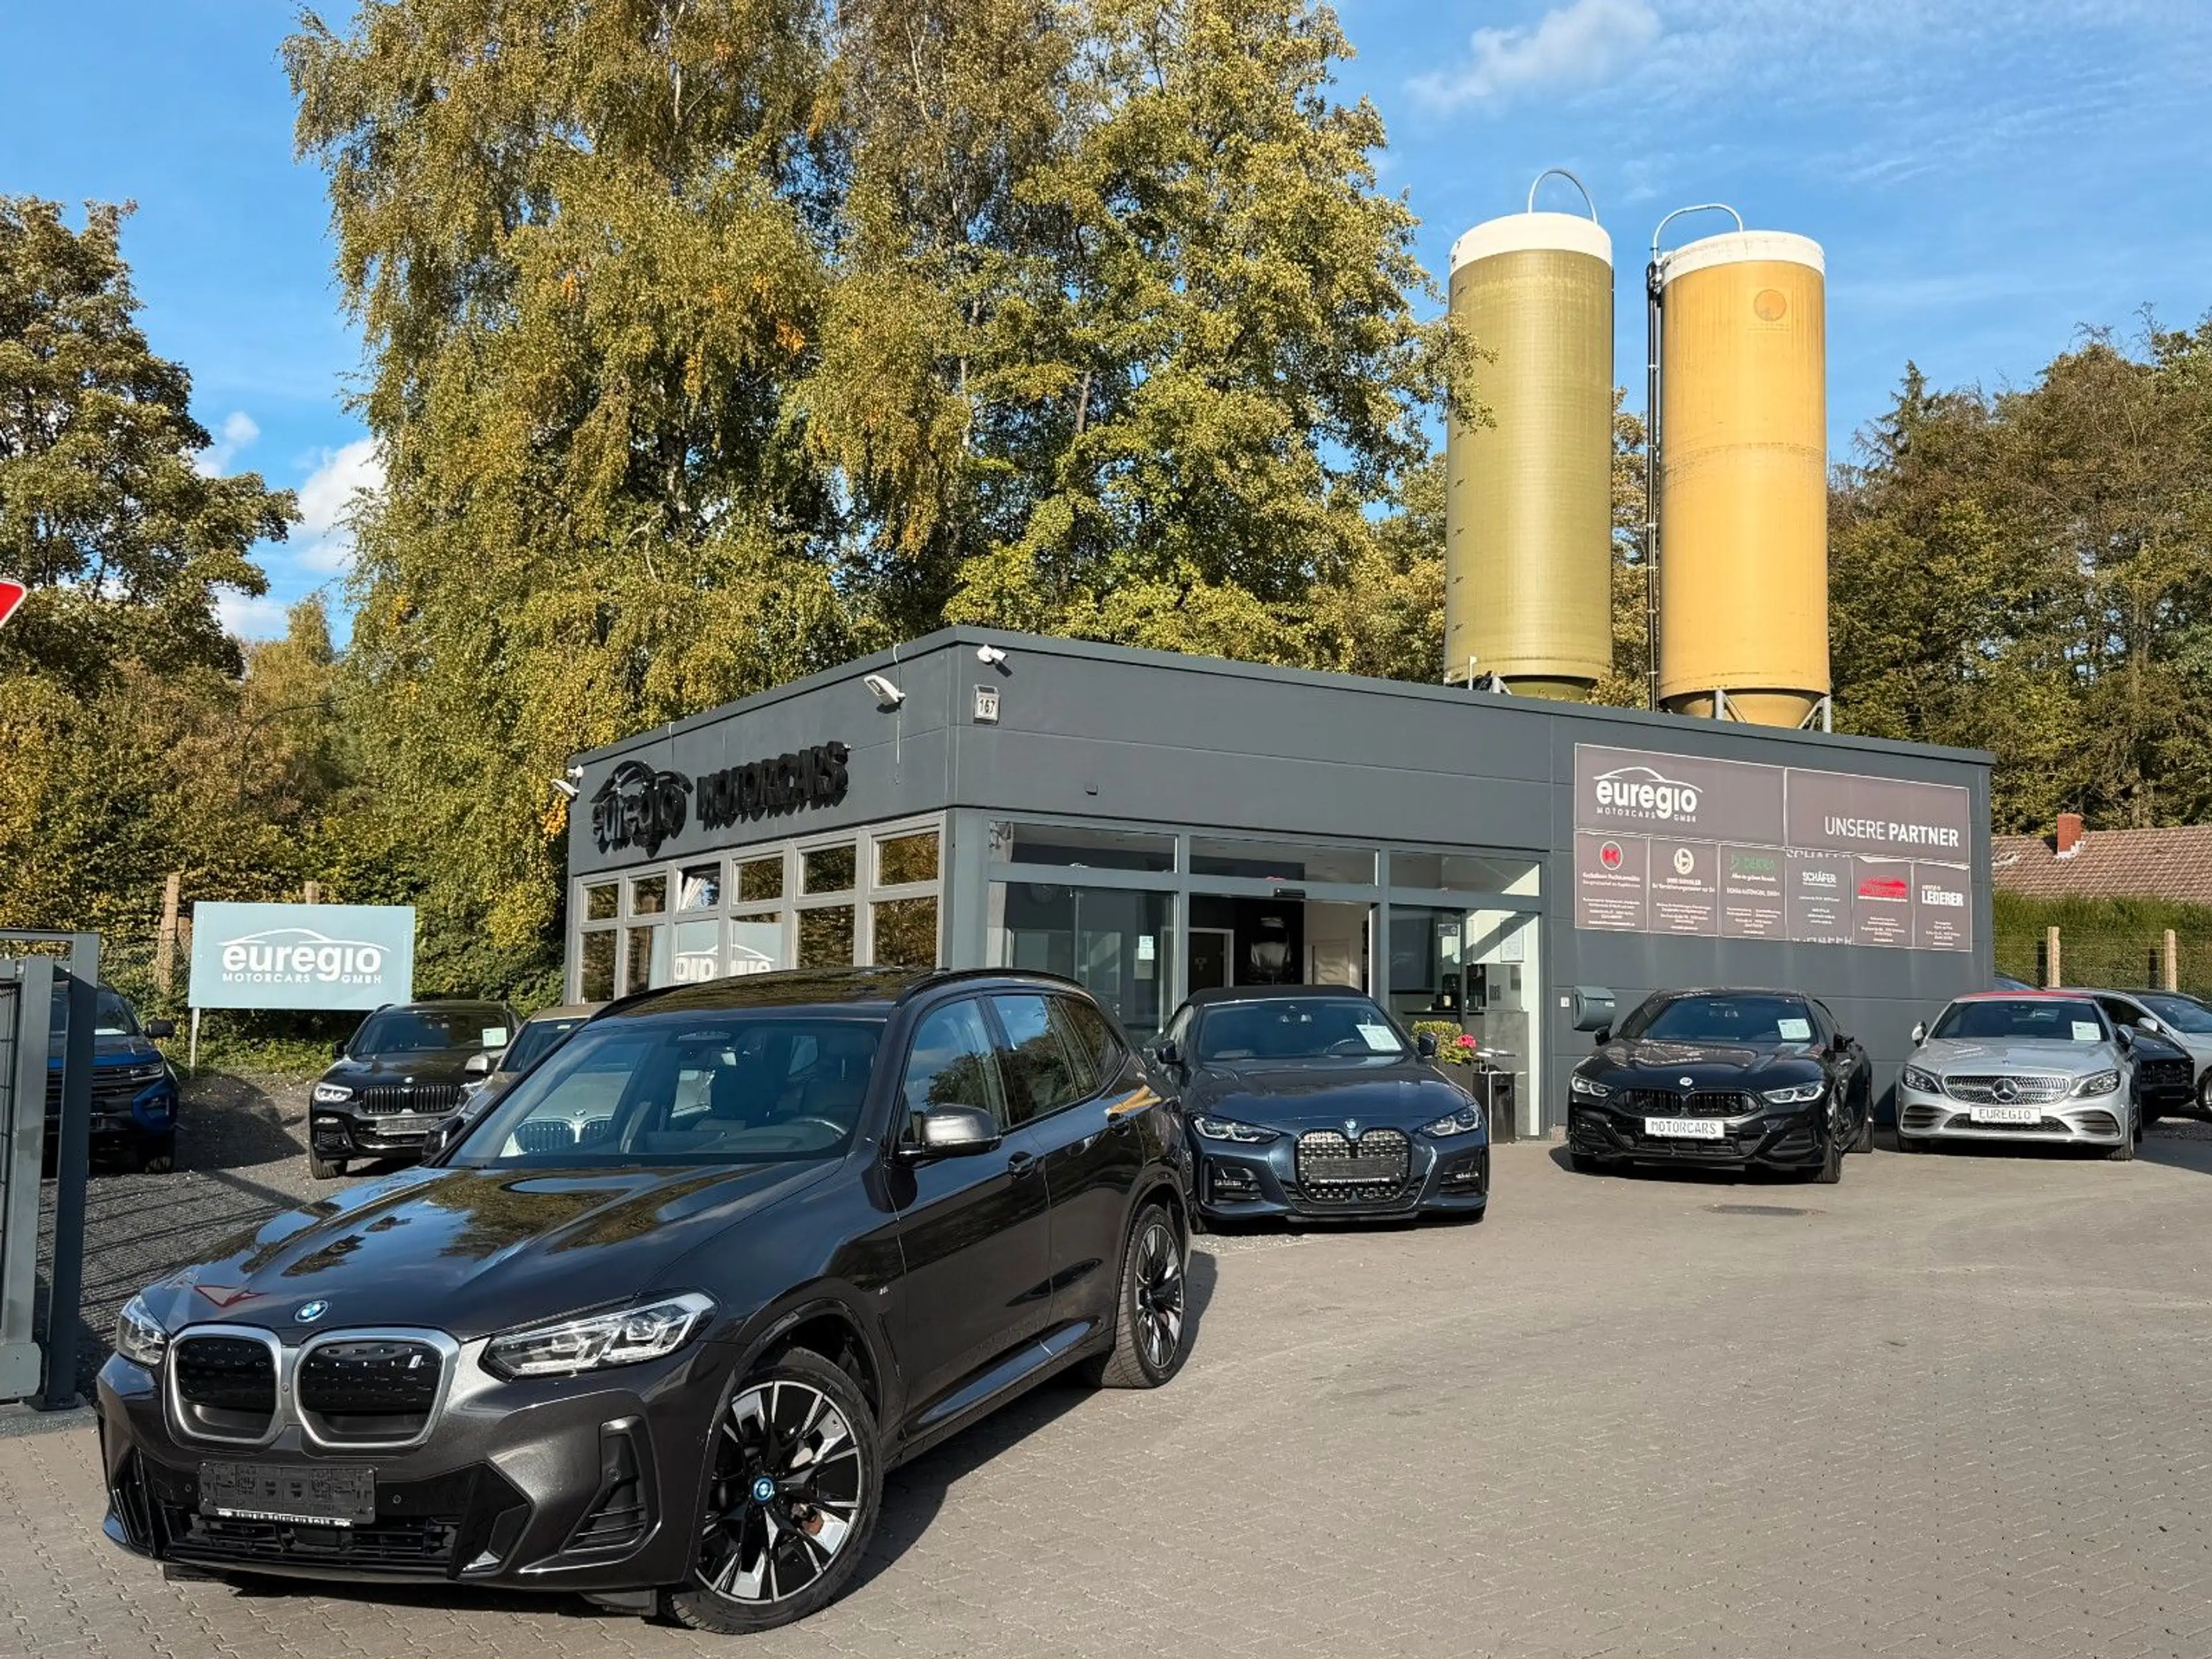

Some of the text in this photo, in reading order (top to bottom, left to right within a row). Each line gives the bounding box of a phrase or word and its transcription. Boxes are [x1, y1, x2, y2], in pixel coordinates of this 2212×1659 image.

[980, 698, 995, 713] 167
[1596, 780, 1697, 819] euregio
[1596, 806, 1656, 819] MOTORCARS
[1825, 816, 1959, 847] UNSERE PARTNER
[1922, 891, 1964, 907] LEDERER
[222, 945, 381, 982] euregio
[222, 972, 382, 984] MOTORCARS GMBH
[1979, 1108, 2031, 1120] EUREGIO
[1651, 1120, 1717, 1134] MOTORCARS
